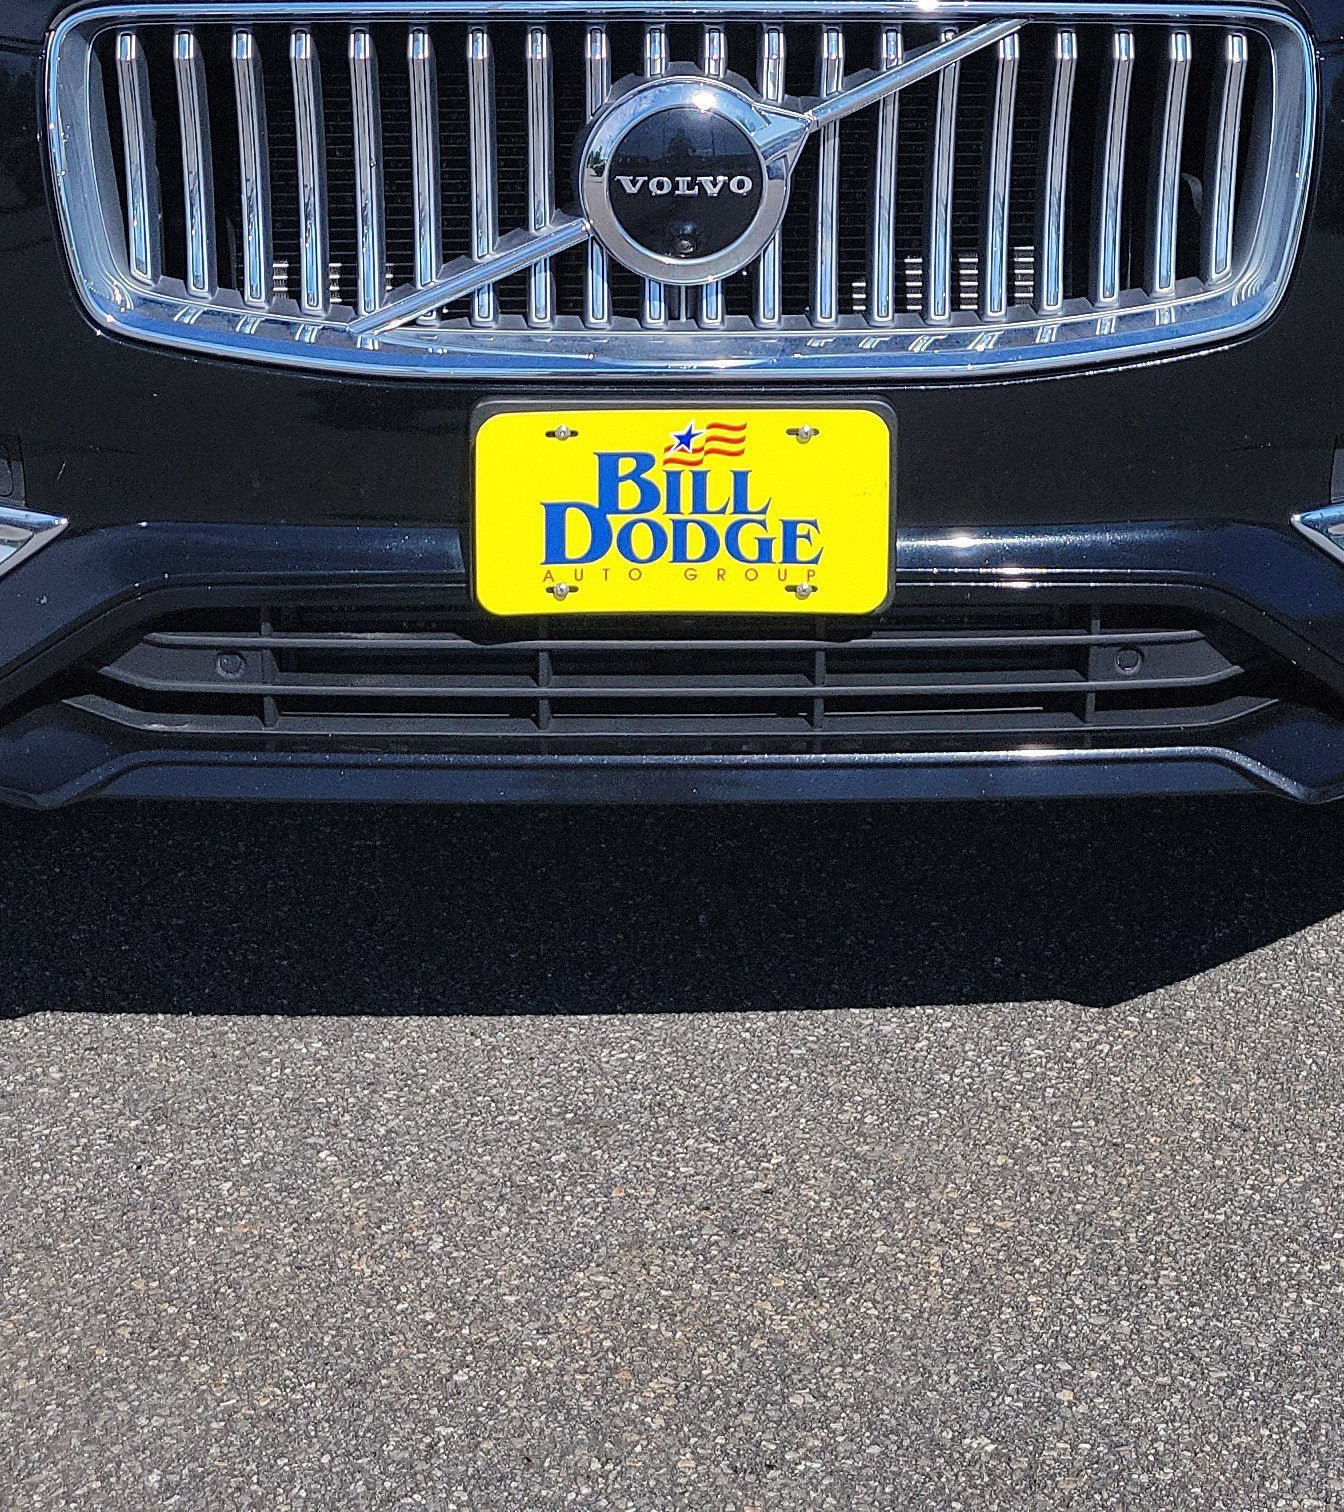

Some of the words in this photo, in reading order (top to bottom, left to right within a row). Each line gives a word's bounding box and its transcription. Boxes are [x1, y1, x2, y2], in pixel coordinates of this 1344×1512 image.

[614, 175, 754, 197] VOLVO
[593, 451, 772, 516] BILL
[539, 501, 825, 566] DODGE
[542, 568, 644, 583] AUTO
[684, 568, 817, 583] GROUP
